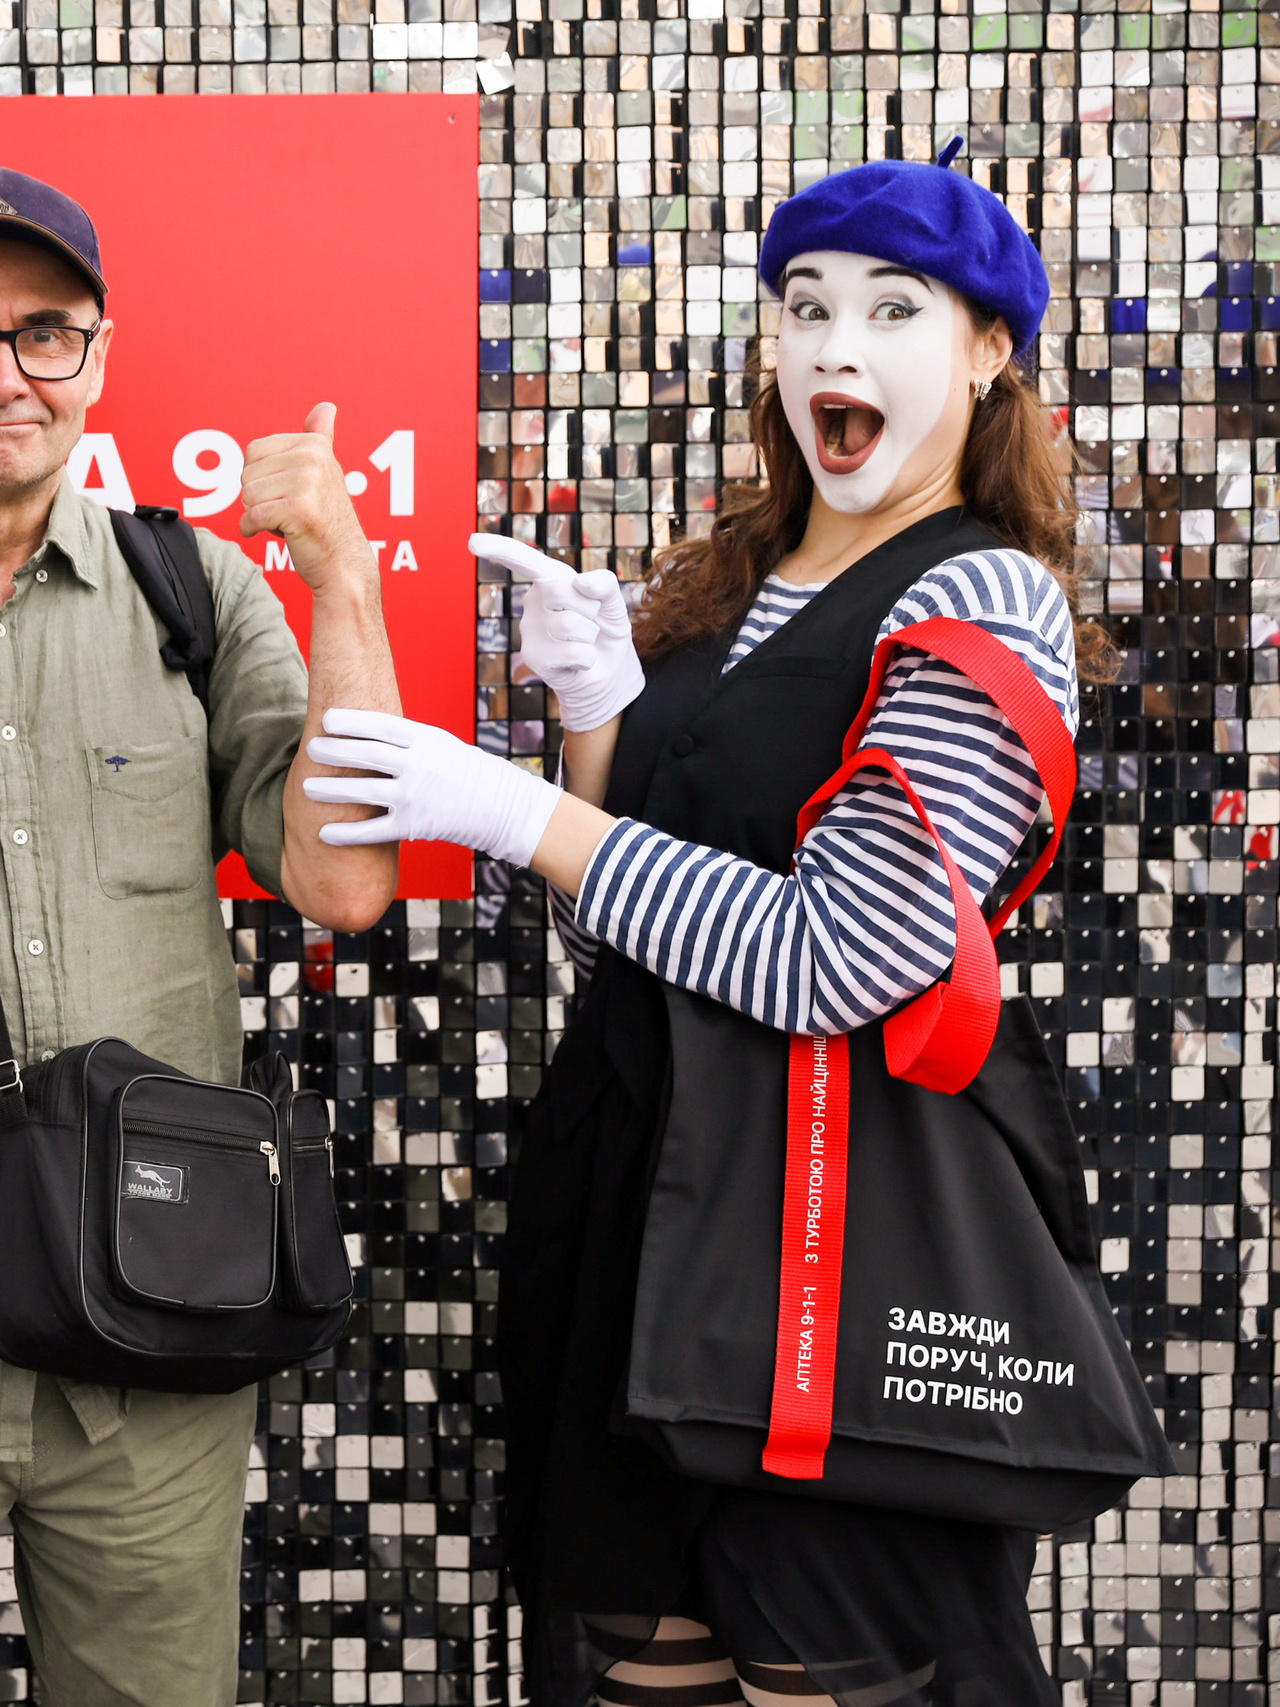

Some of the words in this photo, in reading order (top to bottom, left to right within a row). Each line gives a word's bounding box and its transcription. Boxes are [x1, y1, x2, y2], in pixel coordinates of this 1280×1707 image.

[810, 1121, 826, 1155] ПРО
[127, 1182, 173, 1196] WALLABY
[805, 1158, 824, 1249] ТУРБОТОЮ
[804, 1253, 819, 1264] З
[801, 1286, 817, 1326] 9-1-1
[888, 1306, 1010, 1347] ЗАВЖДИ
[796, 1329, 814, 1393] АПТЕКА
[998, 1355, 1075, 1387] КОЛИ
[883, 1376, 1024, 1415] ПОТРІБНО
